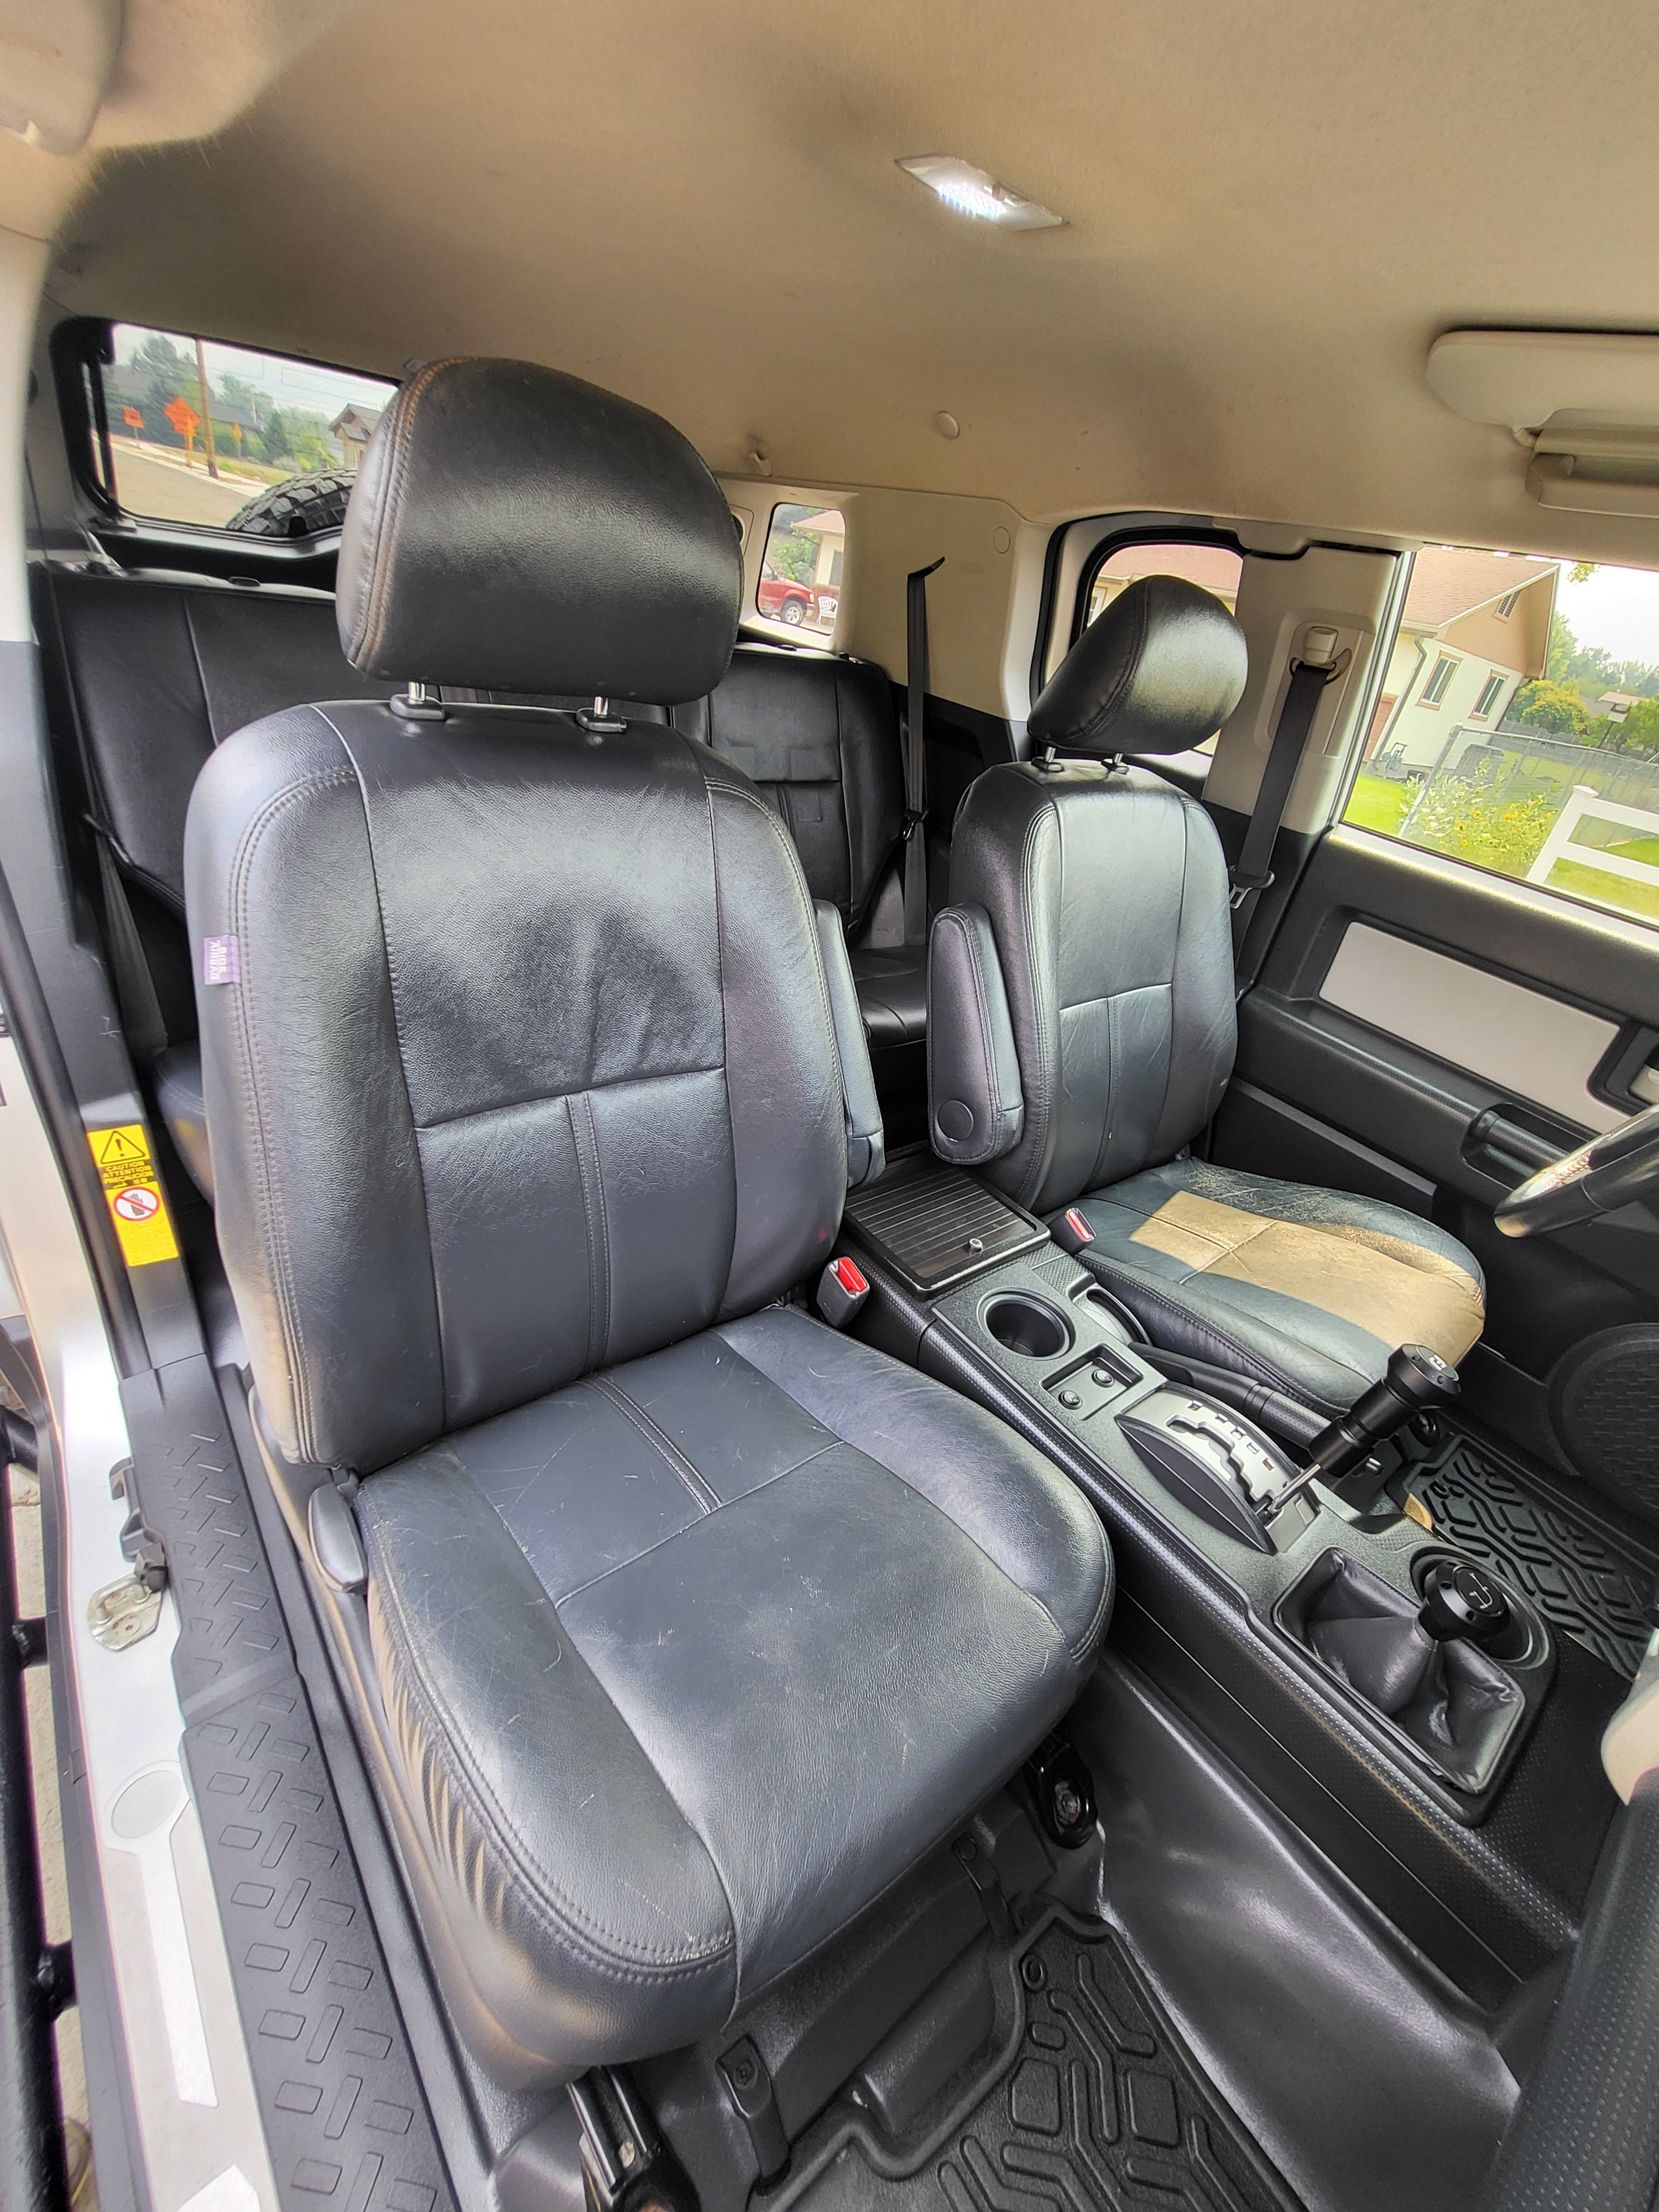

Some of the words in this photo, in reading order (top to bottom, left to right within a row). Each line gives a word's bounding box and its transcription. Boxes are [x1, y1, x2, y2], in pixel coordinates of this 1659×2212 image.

[210, 941, 218, 980] AIRBAG
[103, 1165, 152, 1178] ATTENTION
[106, 1161, 145, 1172] CAUTION
